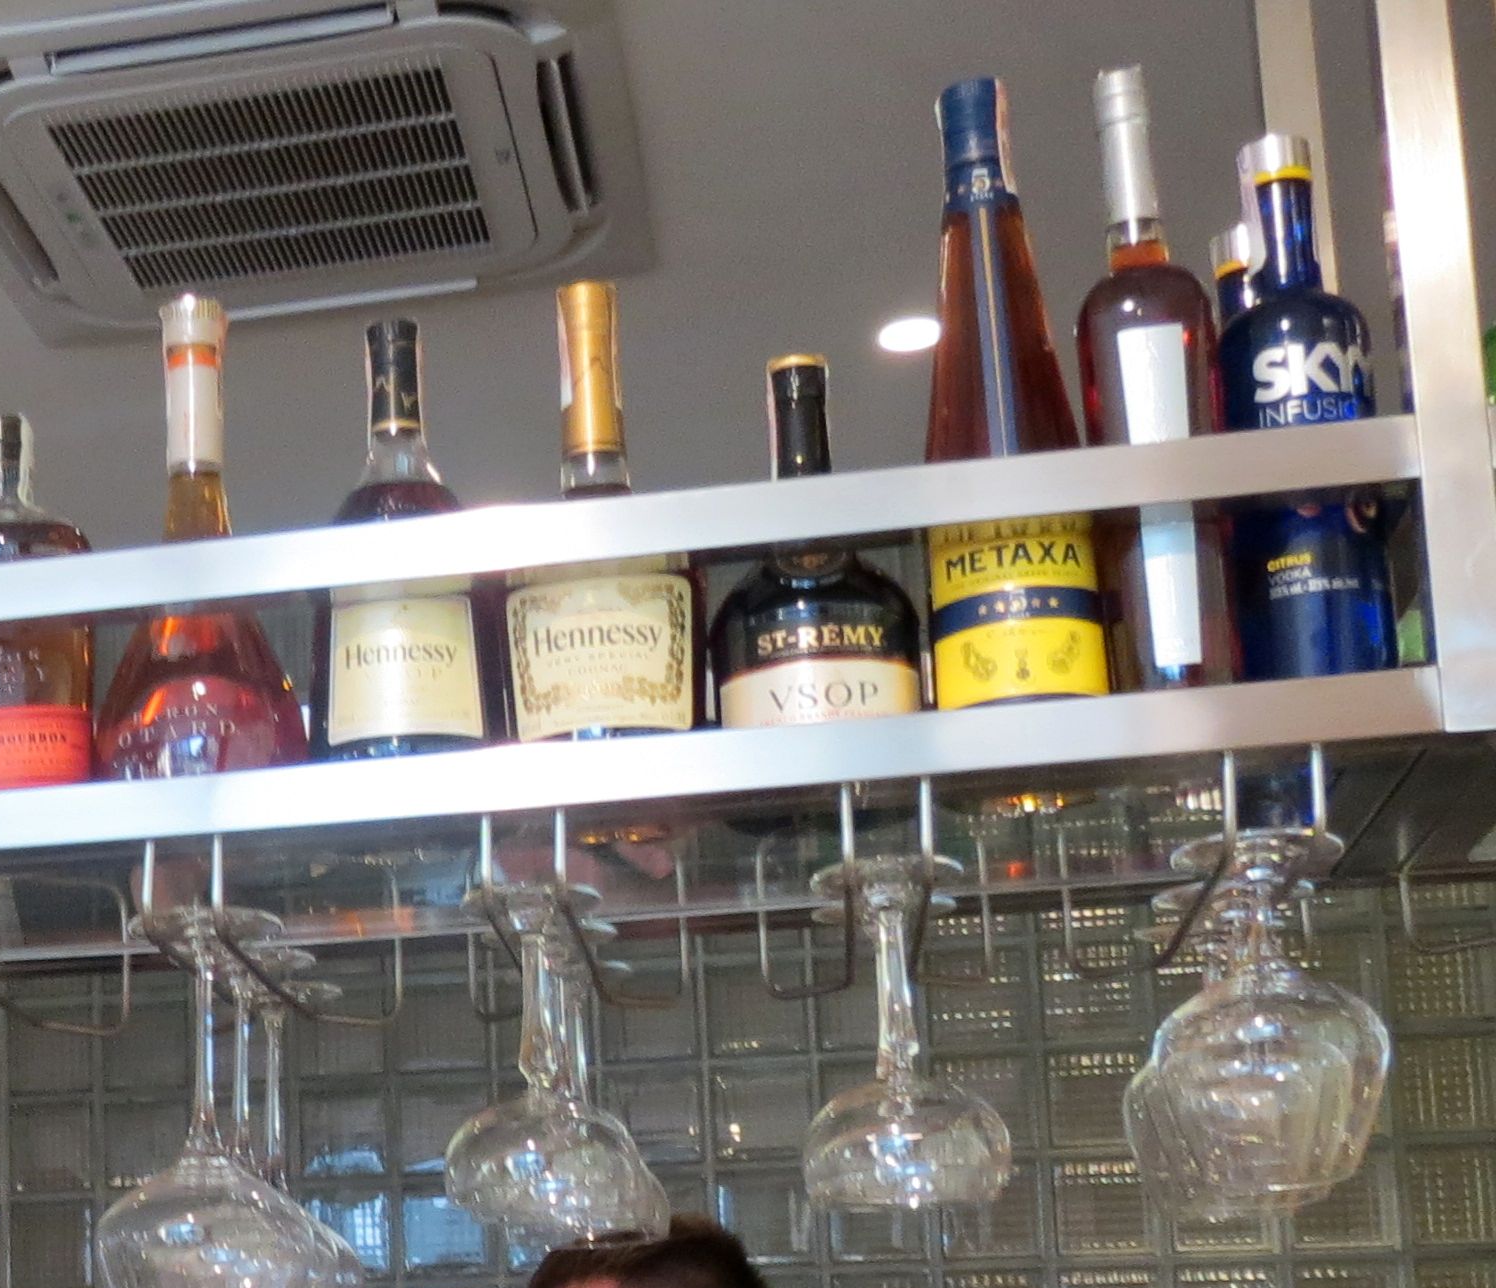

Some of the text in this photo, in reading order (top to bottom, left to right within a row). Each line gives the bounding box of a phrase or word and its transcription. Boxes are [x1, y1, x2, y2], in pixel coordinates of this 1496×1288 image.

[944, 540, 1081, 582] METAXA
[1267, 552, 1312, 573] CITRUS
[533, 623, 663, 657] Hennessy
[757, 621, 884, 657] ST-RÉMY
[345, 643, 457, 670] Hennessy
[768, 679, 879, 714] VSOP
